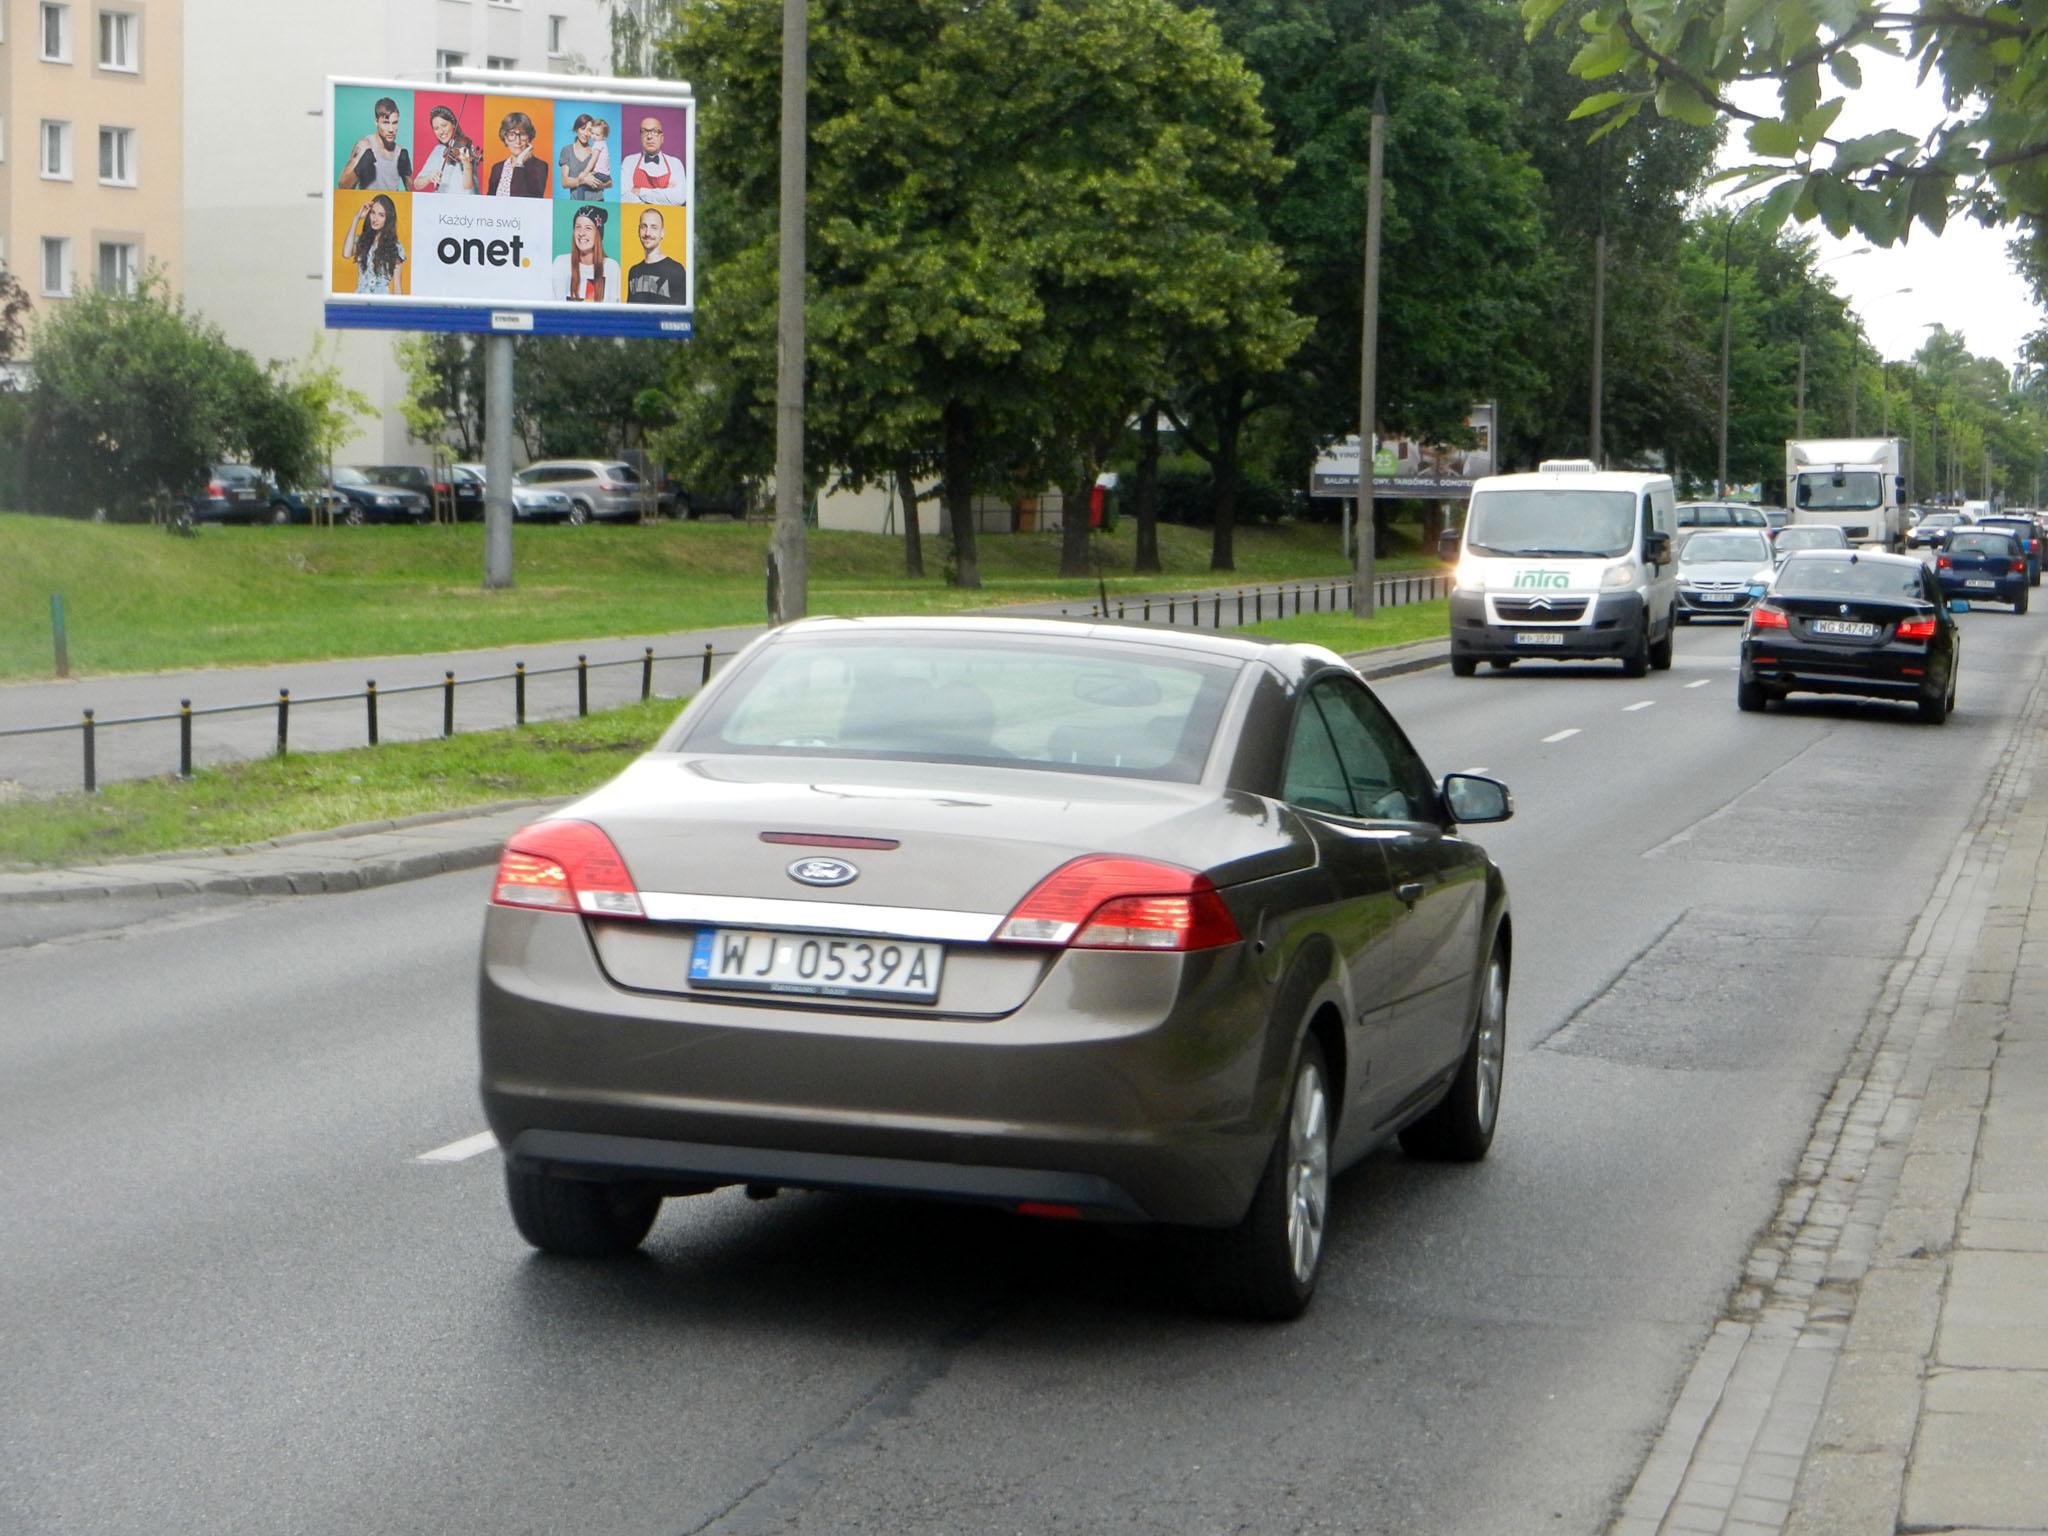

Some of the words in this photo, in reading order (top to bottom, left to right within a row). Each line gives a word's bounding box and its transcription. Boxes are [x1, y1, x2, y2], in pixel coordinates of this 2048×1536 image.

[439, 214, 474, 228] Każdy
[477, 218, 494, 227] ma
[496, 217, 521, 230] swój
[1514, 569, 1570, 588] intra
[721, 934, 777, 976] WJ
[798, 940, 927, 988] 0539A
